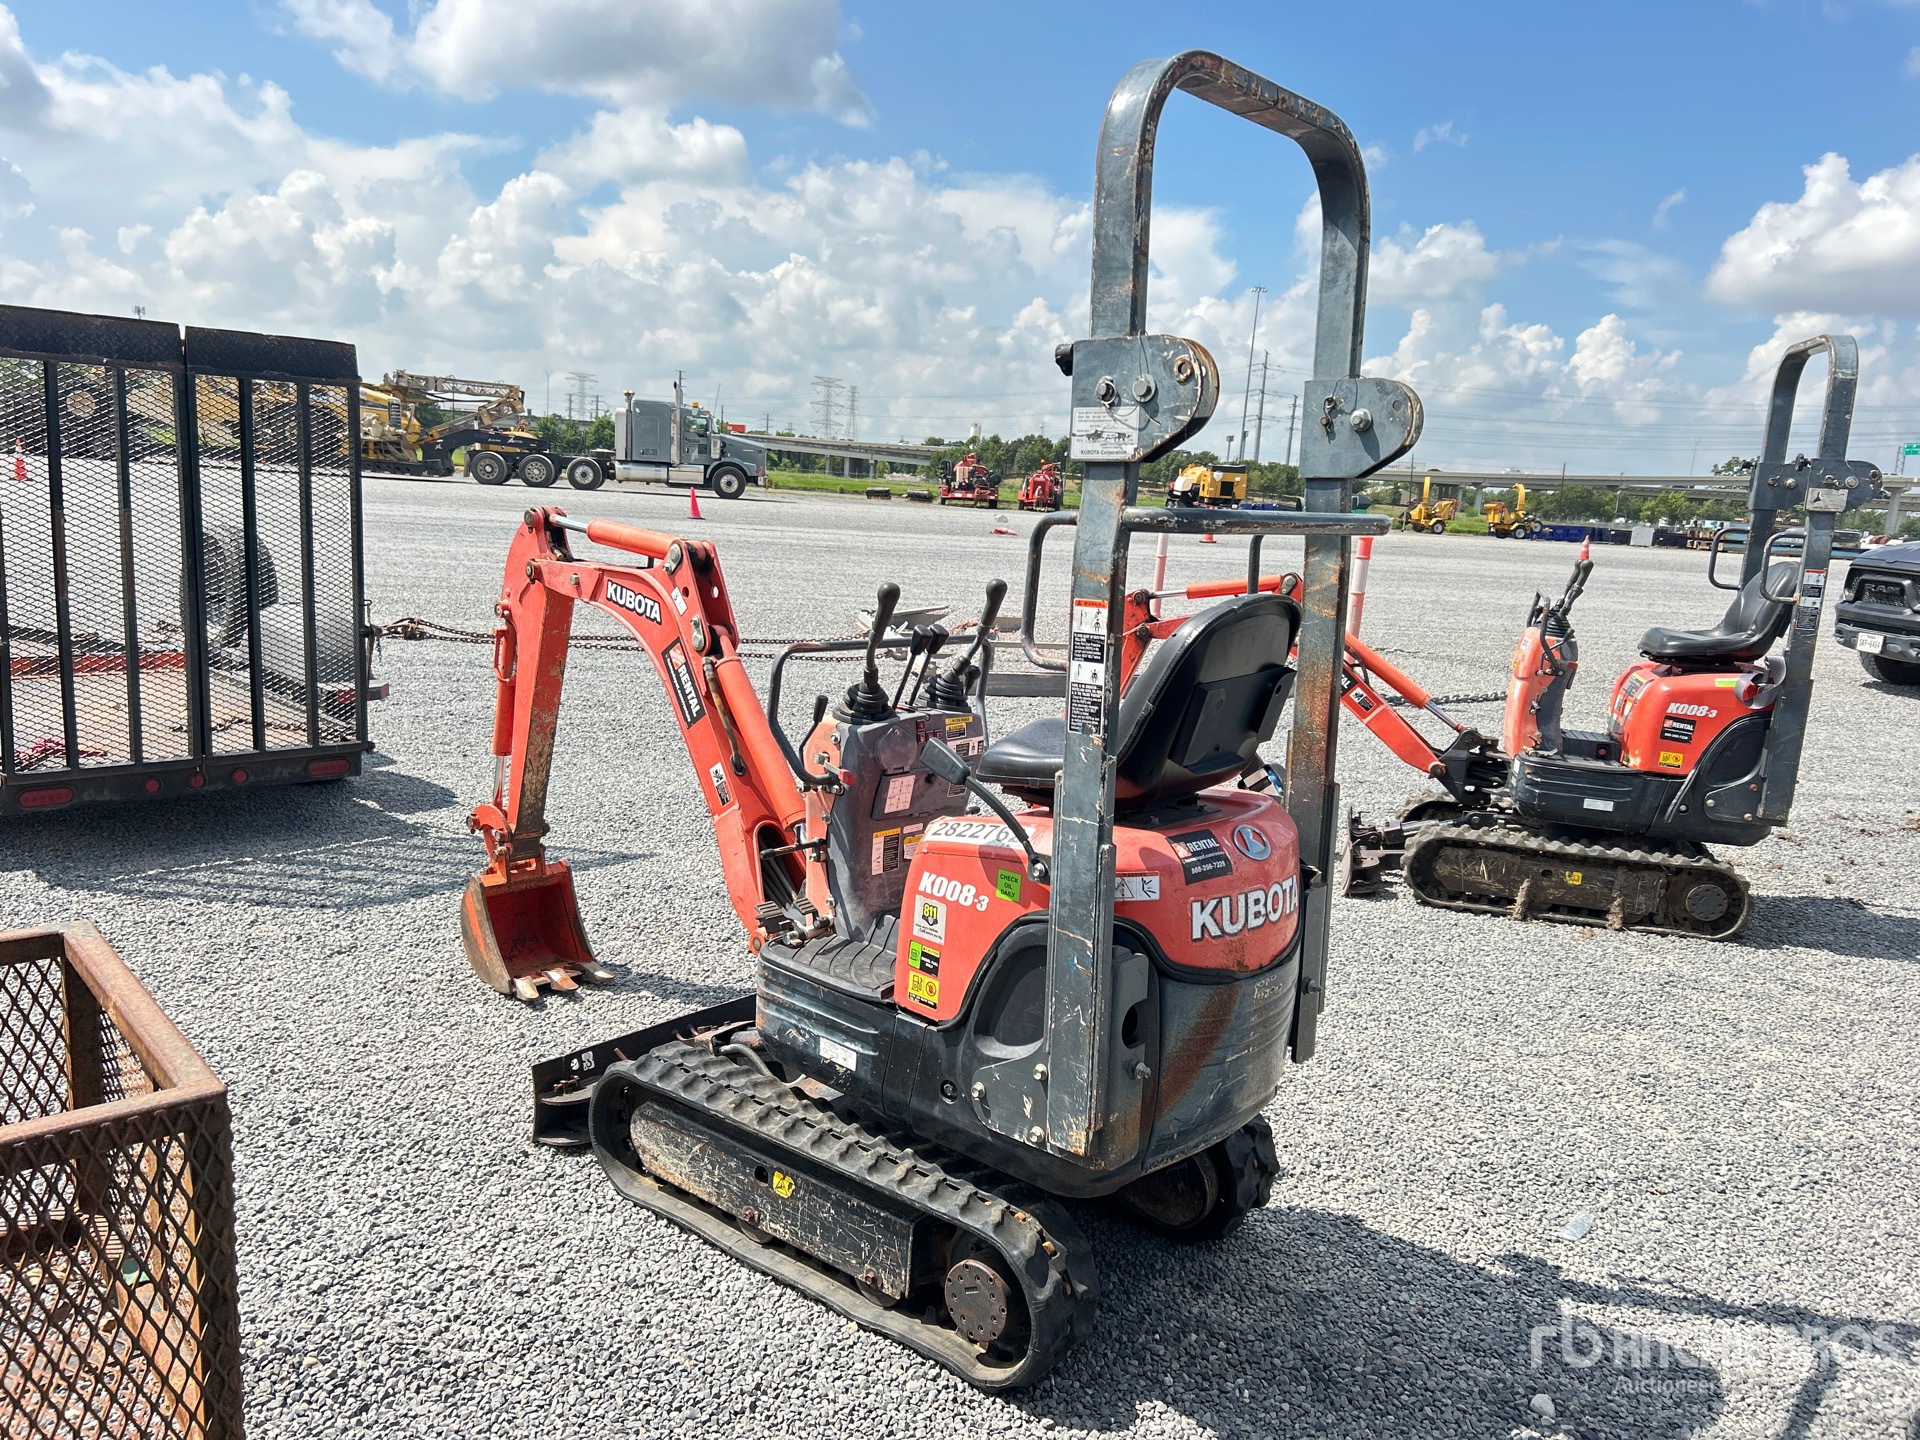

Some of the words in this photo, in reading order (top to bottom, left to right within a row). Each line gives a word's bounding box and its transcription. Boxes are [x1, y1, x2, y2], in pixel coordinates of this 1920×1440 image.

[607, 580, 662, 624] KUBOTA
[678, 664, 701, 718] RENTAL
[1666, 702, 1718, 718] K008-3
[1672, 721, 1694, 731] RENTAL
[1187, 838, 1220, 852] RENTAL
[1000, 873, 1018, 883] CHECK
[1004, 882, 1013, 890] OIL
[918, 870, 989, 911] K008-3
[1001, 888, 1016, 899] DAILY
[923, 903, 938, 919] 811
[1191, 874, 1299, 941] KUBOTA
